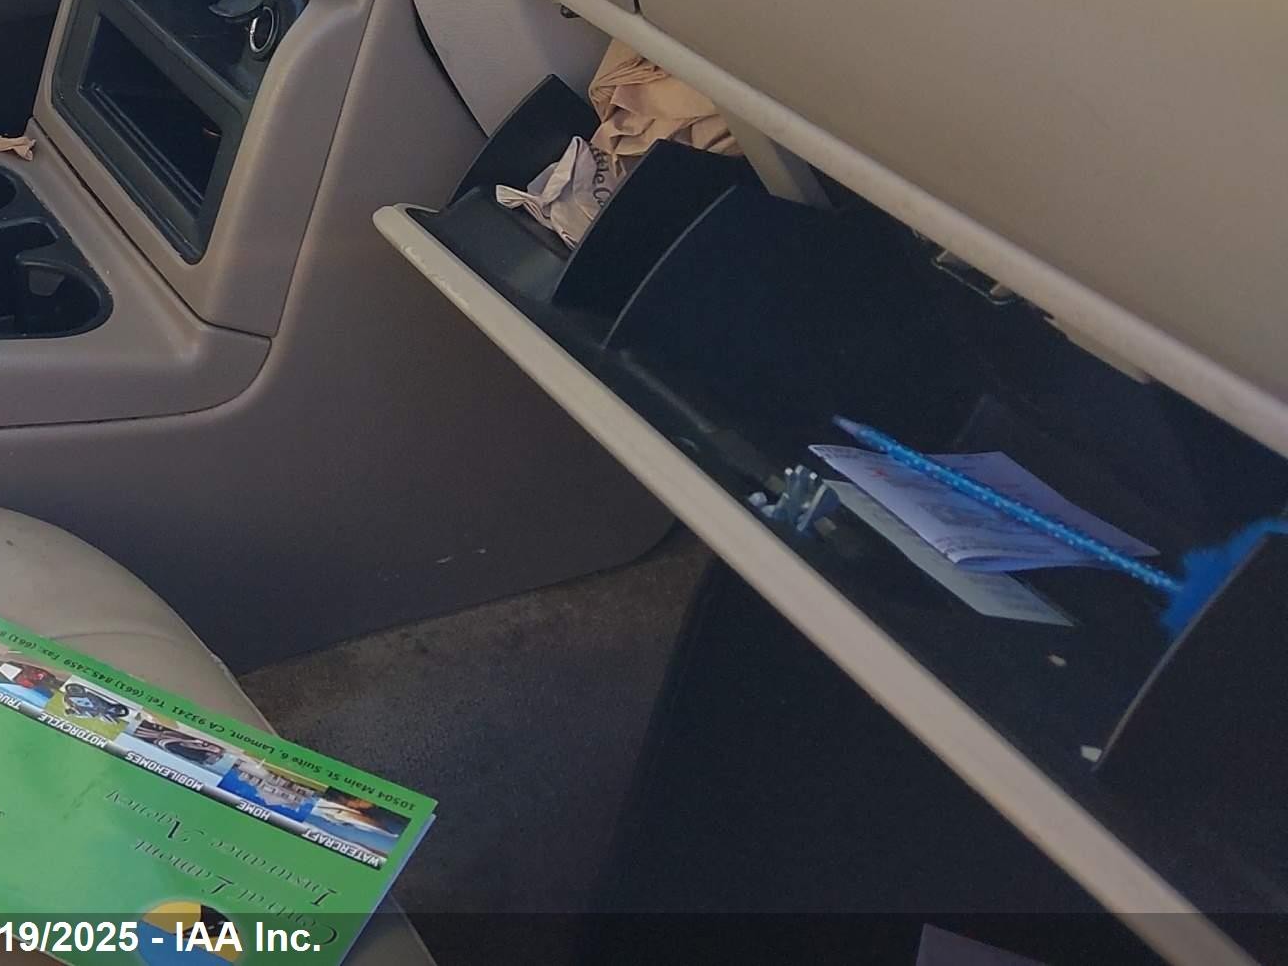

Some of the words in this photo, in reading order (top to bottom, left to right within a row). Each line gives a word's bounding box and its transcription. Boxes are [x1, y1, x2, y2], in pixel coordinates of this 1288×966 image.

[7, 631, 37, 651] (661)
[113, 679, 144, 698] (661)
[171, 704, 207, 726] 93241
[207, 720, 225, 733] CA
[37, 710, 108, 748] MOTORCYCLE
[227, 728, 275, 754] Lamont,
[124, 749, 203, 791] MOBILEHOMES
[290, 754, 322, 774] Suite
[324, 768, 341, 782] St.
[342, 775, 375, 796] Main
[236, 798, 271, 821] HOME
[376, 789, 416, 812] 10504
[105, 789, 205, 845] Agency
[301, 825, 380, 868] WATERCRAFT
[133, 838, 234, 895] Lamont
[211, 837, 337, 907] Insurance
